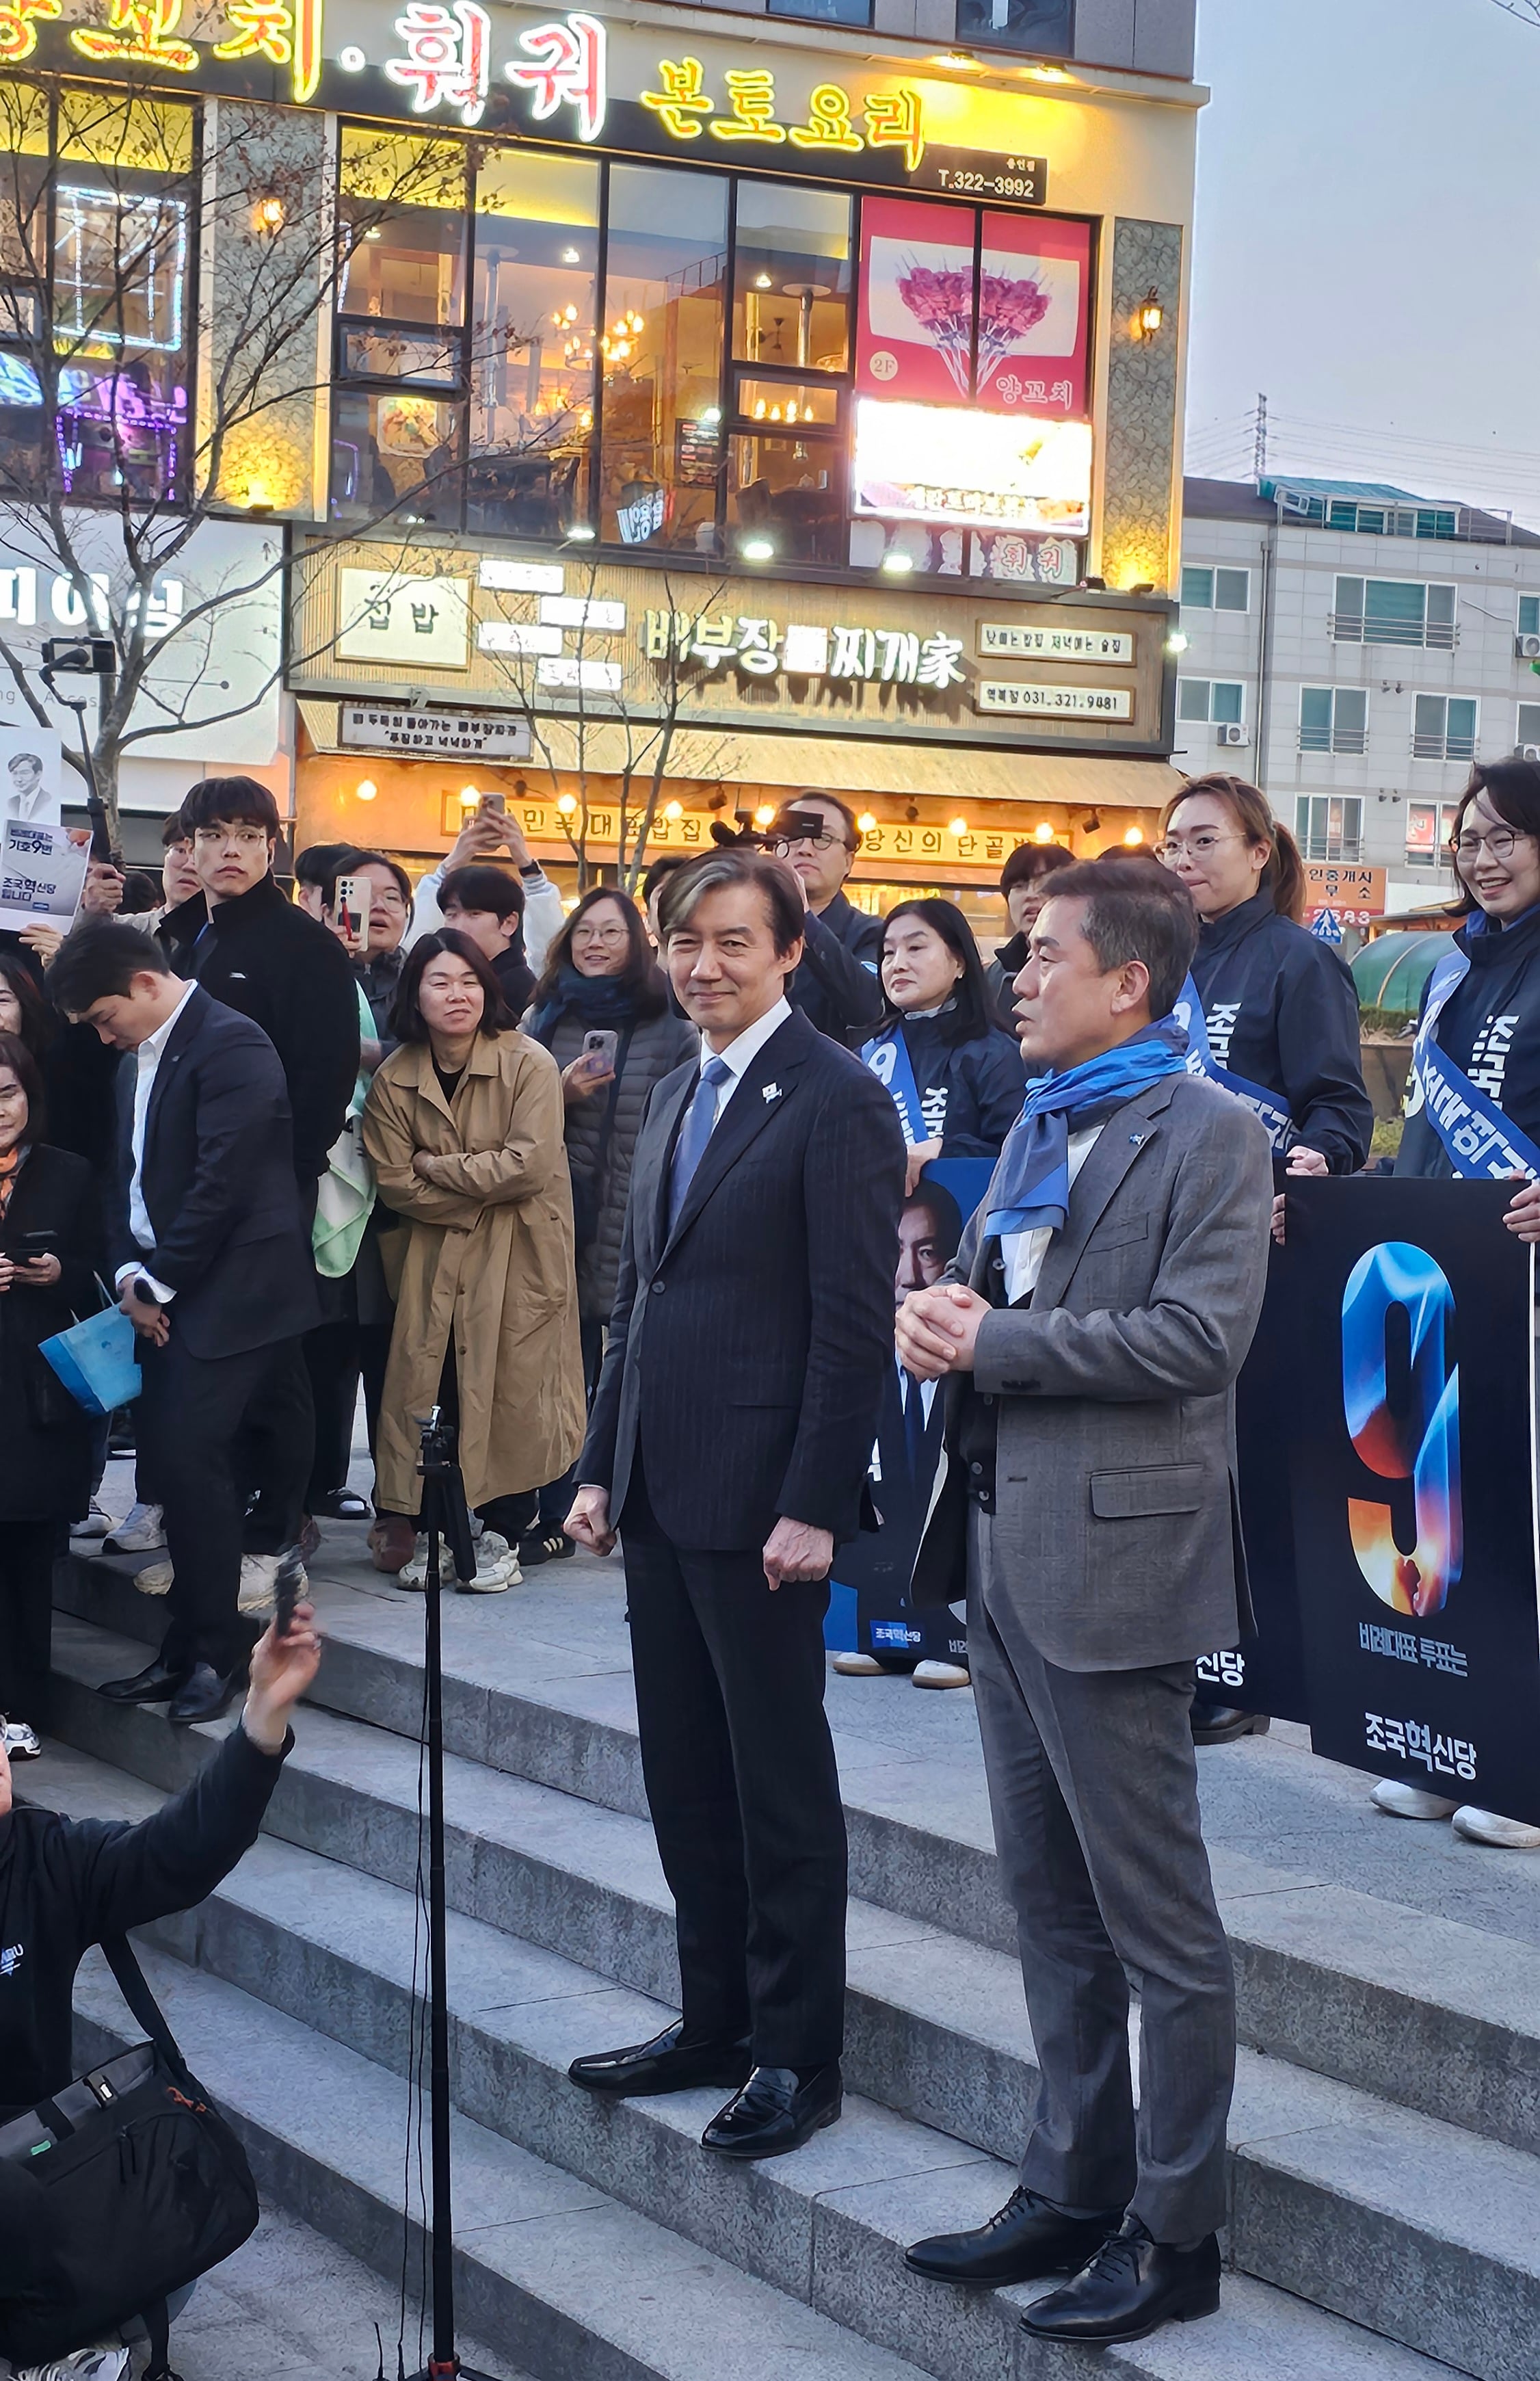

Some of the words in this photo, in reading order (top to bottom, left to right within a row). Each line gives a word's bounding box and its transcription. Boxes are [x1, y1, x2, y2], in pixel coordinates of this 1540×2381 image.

[639, 56, 927, 172] 본토요리
[938, 168, 1035, 198] T.322-3992
[873, 358, 894, 373] 2F
[995, 374, 1074, 411] 양꼬치
[9, 839, 53, 856] 기호9번
[865, 828, 942, 853] 당신의
[2, 877, 57, 895] 조국혁신당
[1342, 1241, 1464, 1616] 9
[1358, 1621, 1418, 1664] 비례대표
[1419, 1636, 1469, 1678] 투표는
[1364, 1711, 1478, 1780] 조국혁신당
